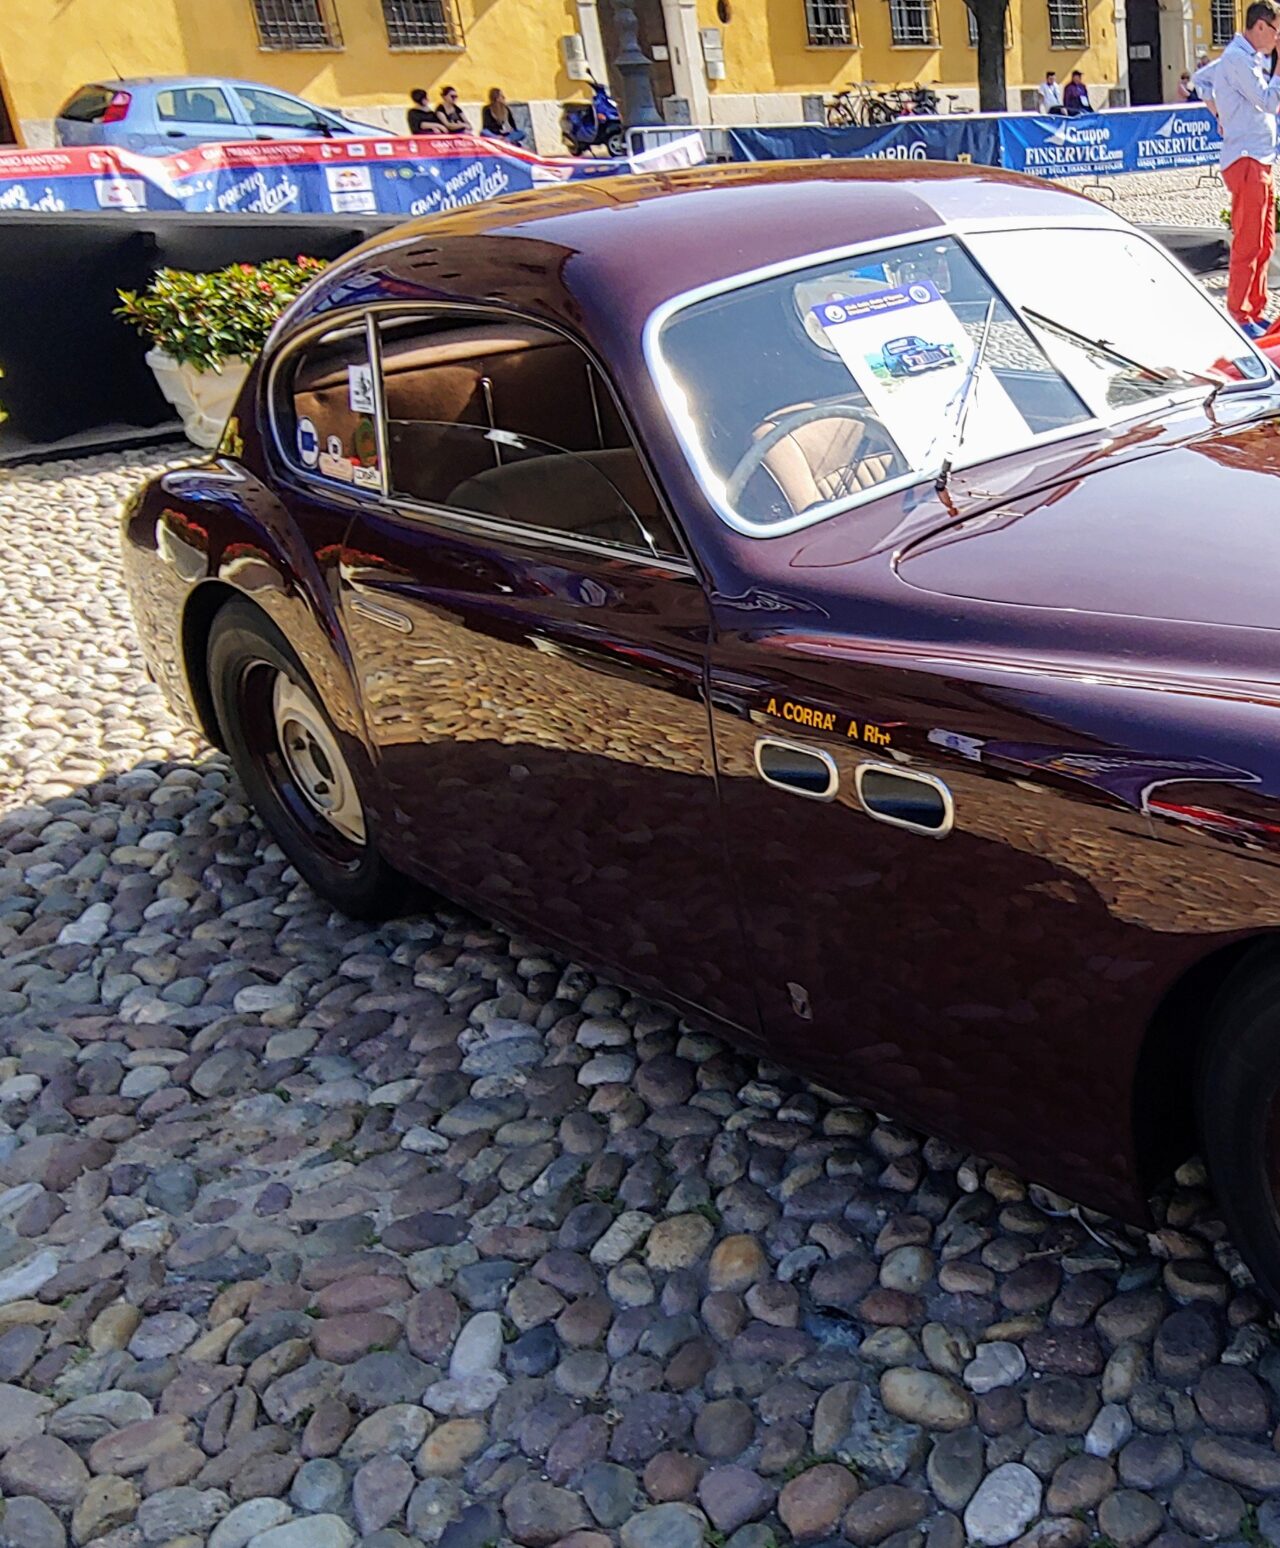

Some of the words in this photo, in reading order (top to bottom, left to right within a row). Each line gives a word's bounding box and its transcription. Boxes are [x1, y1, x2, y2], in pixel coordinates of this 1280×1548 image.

[1066, 127, 1110, 144] Gruppo
[1174, 119, 1211, 136] Gruppo
[217, 171, 265, 212] PREMIO
[445, 161, 484, 195] PREMIO
[766, 698, 782, 717] A.
[783, 702, 837, 731] CORRA'
[847, 720, 859, 739] A
